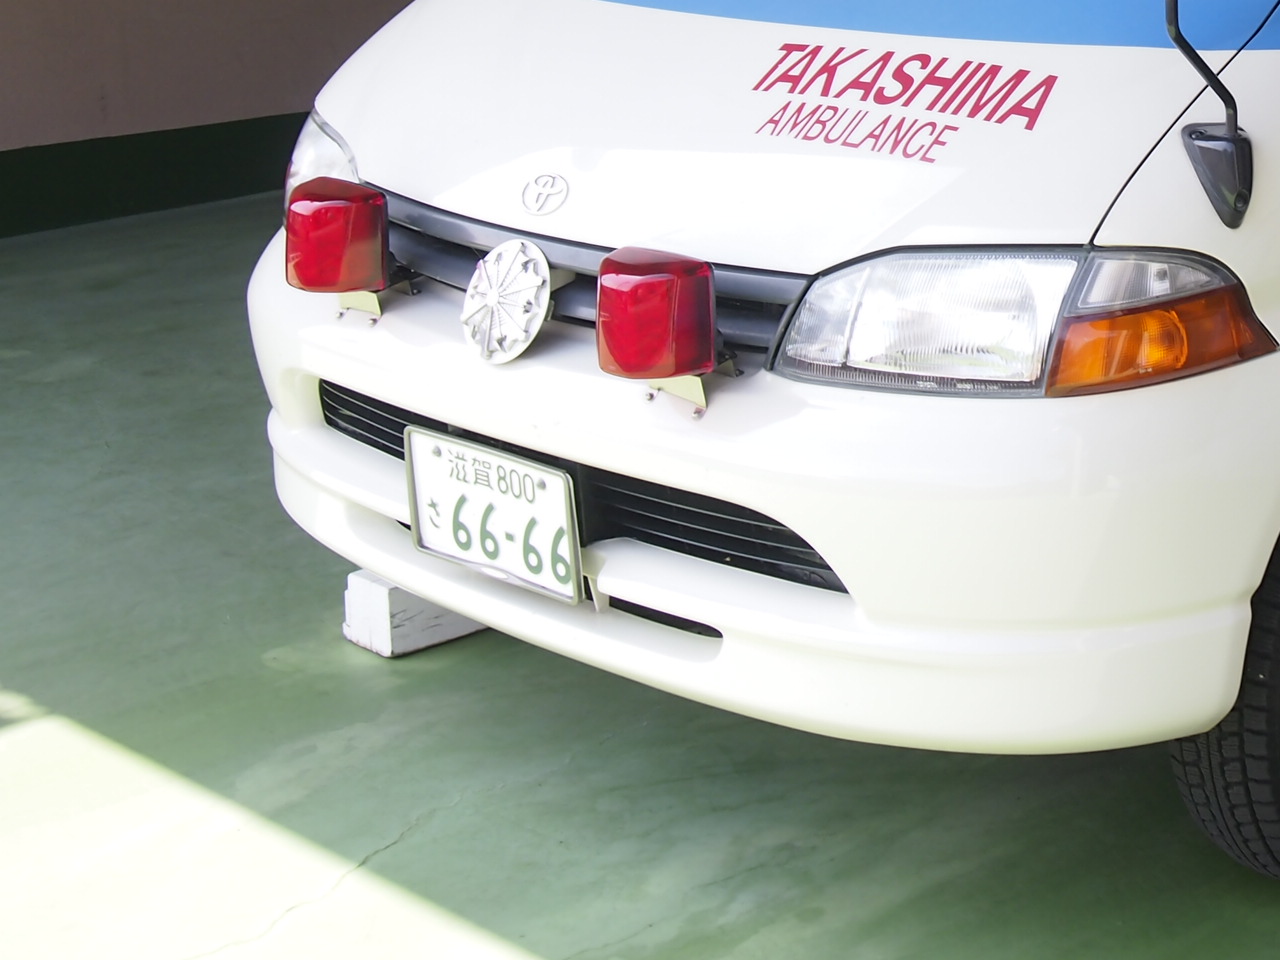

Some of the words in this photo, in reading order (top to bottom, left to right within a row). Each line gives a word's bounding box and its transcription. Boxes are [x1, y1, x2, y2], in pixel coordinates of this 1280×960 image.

[752, 43, 1058, 131] TAKASHIMA
[755, 101, 960, 164] AMBULANCE
[452, 493, 571, 585] 66-66
